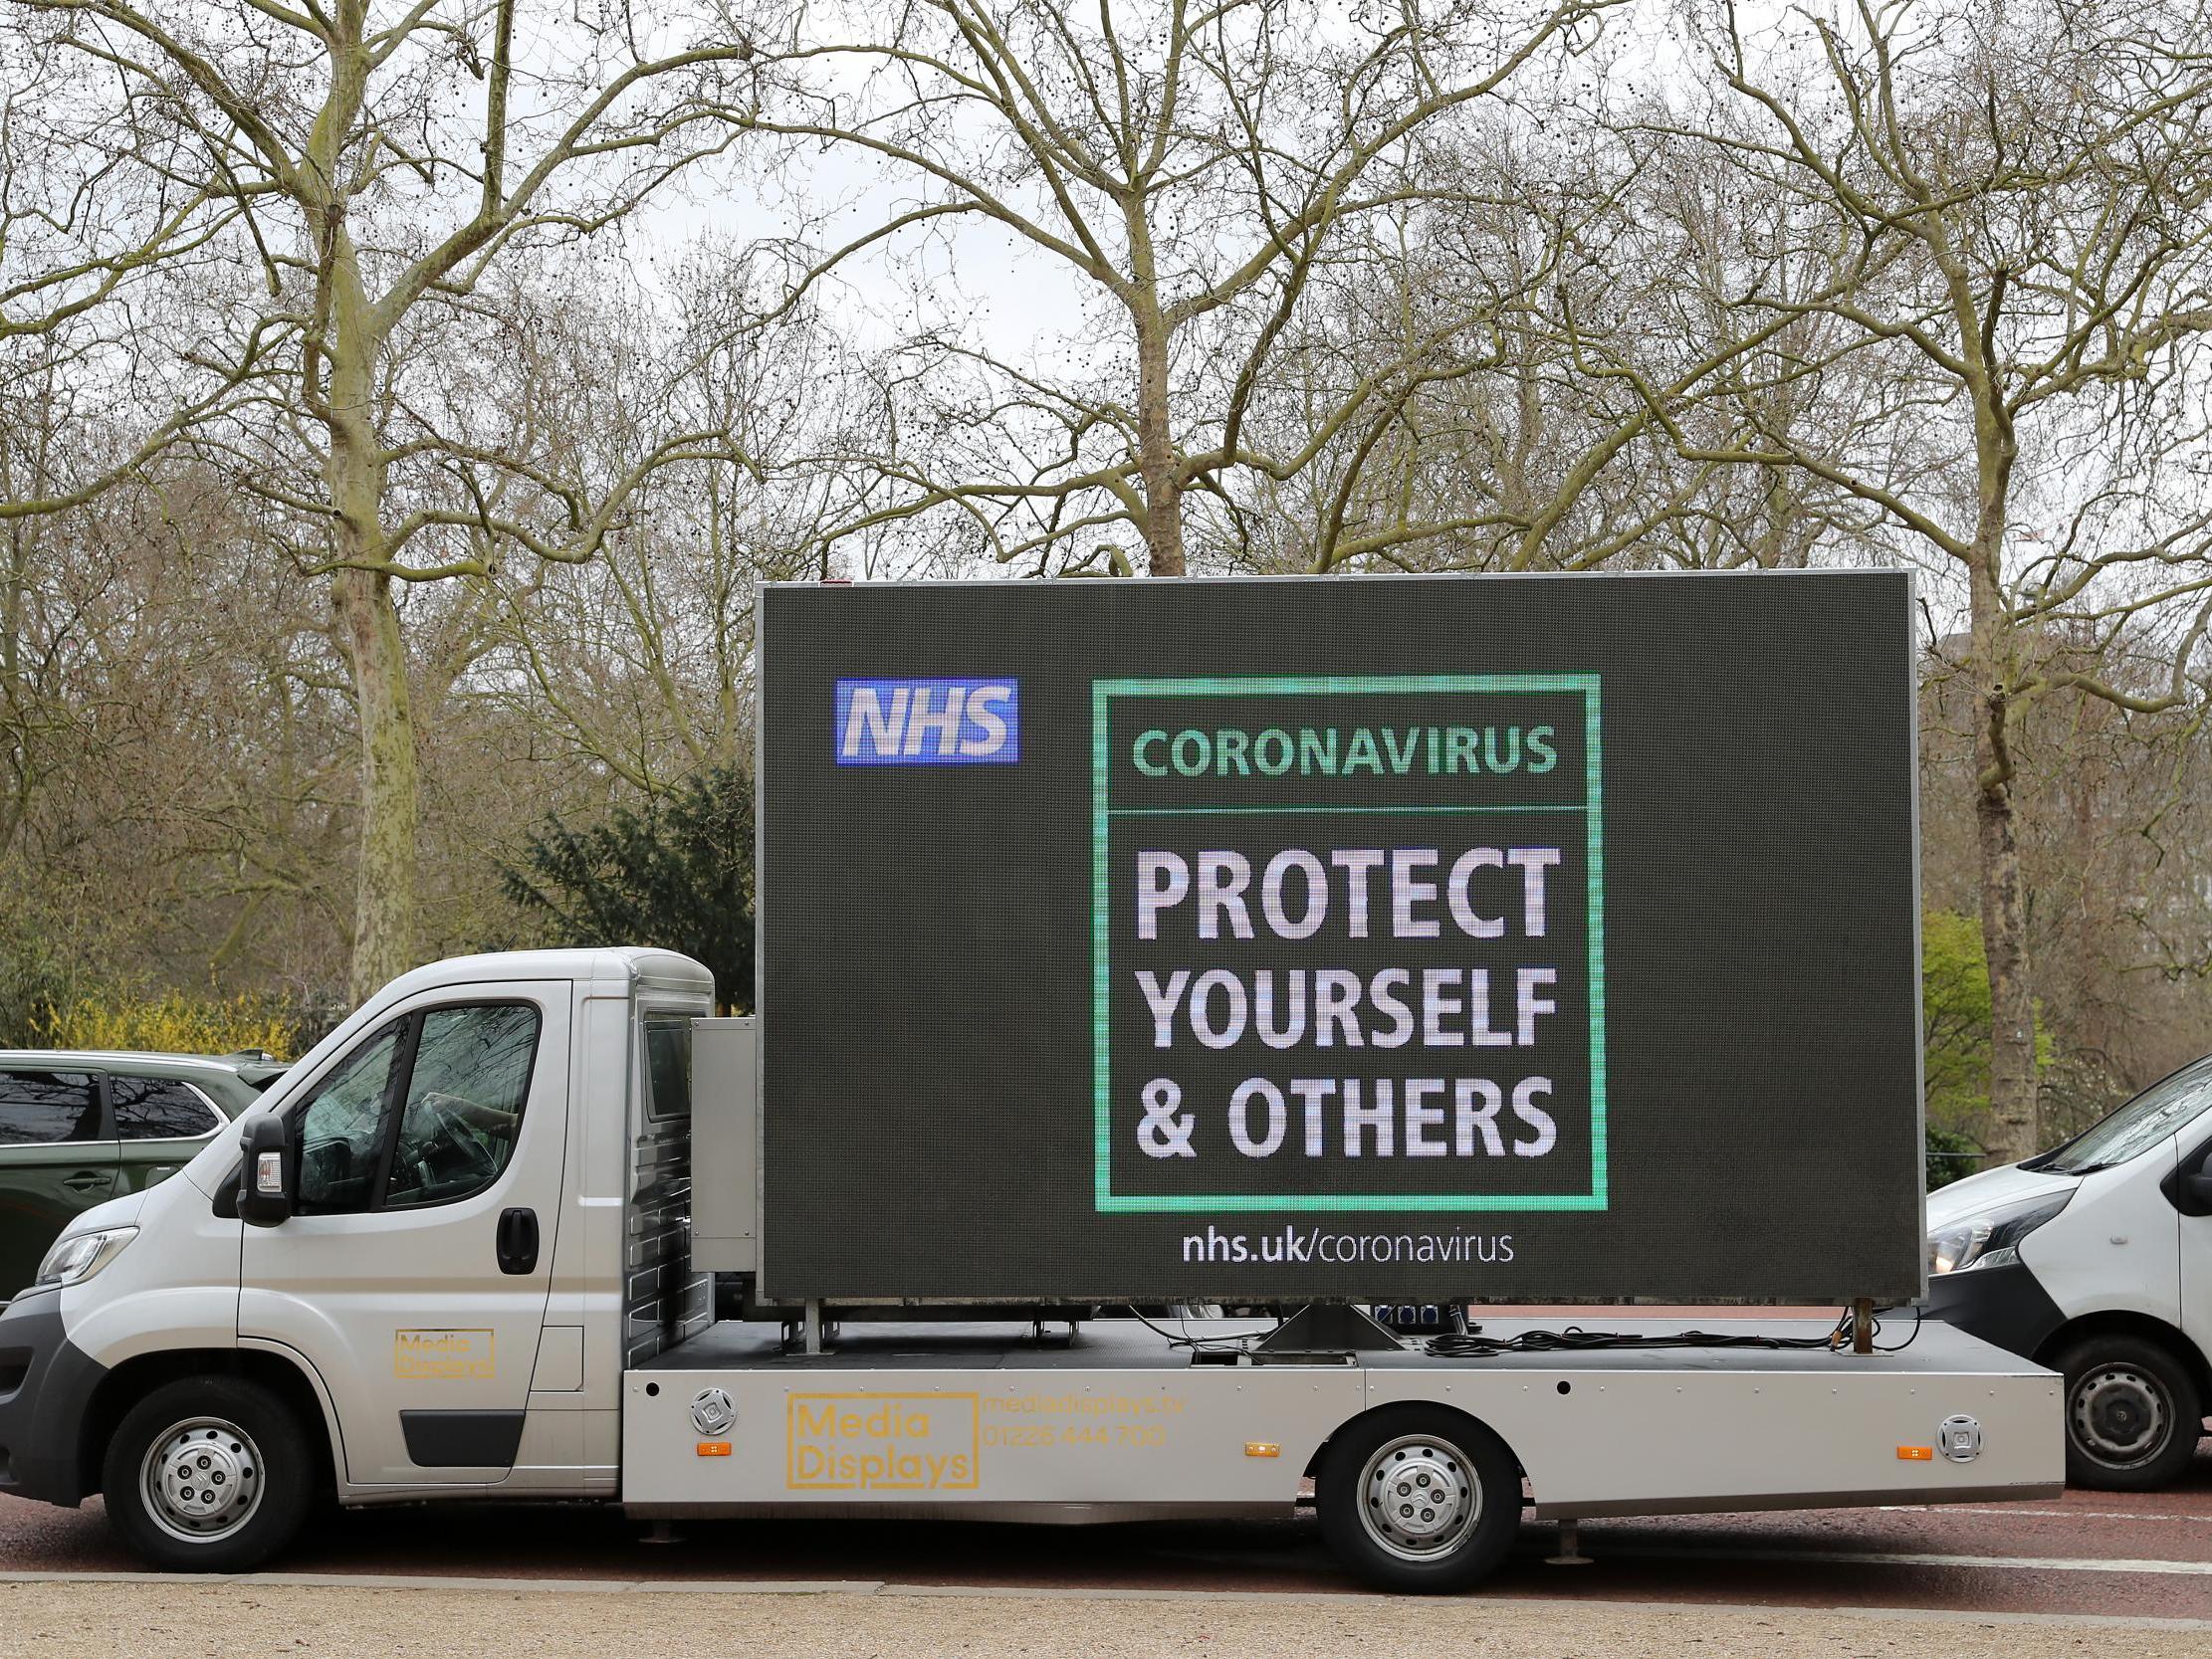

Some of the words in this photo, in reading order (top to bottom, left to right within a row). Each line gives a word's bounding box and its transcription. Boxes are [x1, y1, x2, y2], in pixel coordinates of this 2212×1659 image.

[841, 685, 1011, 756] NHS
[1132, 726, 1558, 776] CORONAVIRUS
[1137, 847, 1561, 939] PROTECT
[1134, 967, 1558, 1049] YOURSELF
[1136, 1078, 1197, 1158] &
[1227, 1076, 1558, 1158] OTHERS
[1183, 1225, 1514, 1262] nhs.uk/coronavirus
[798, 1404, 932, 1439] Media
[798, 1444, 968, 1489] Displays
